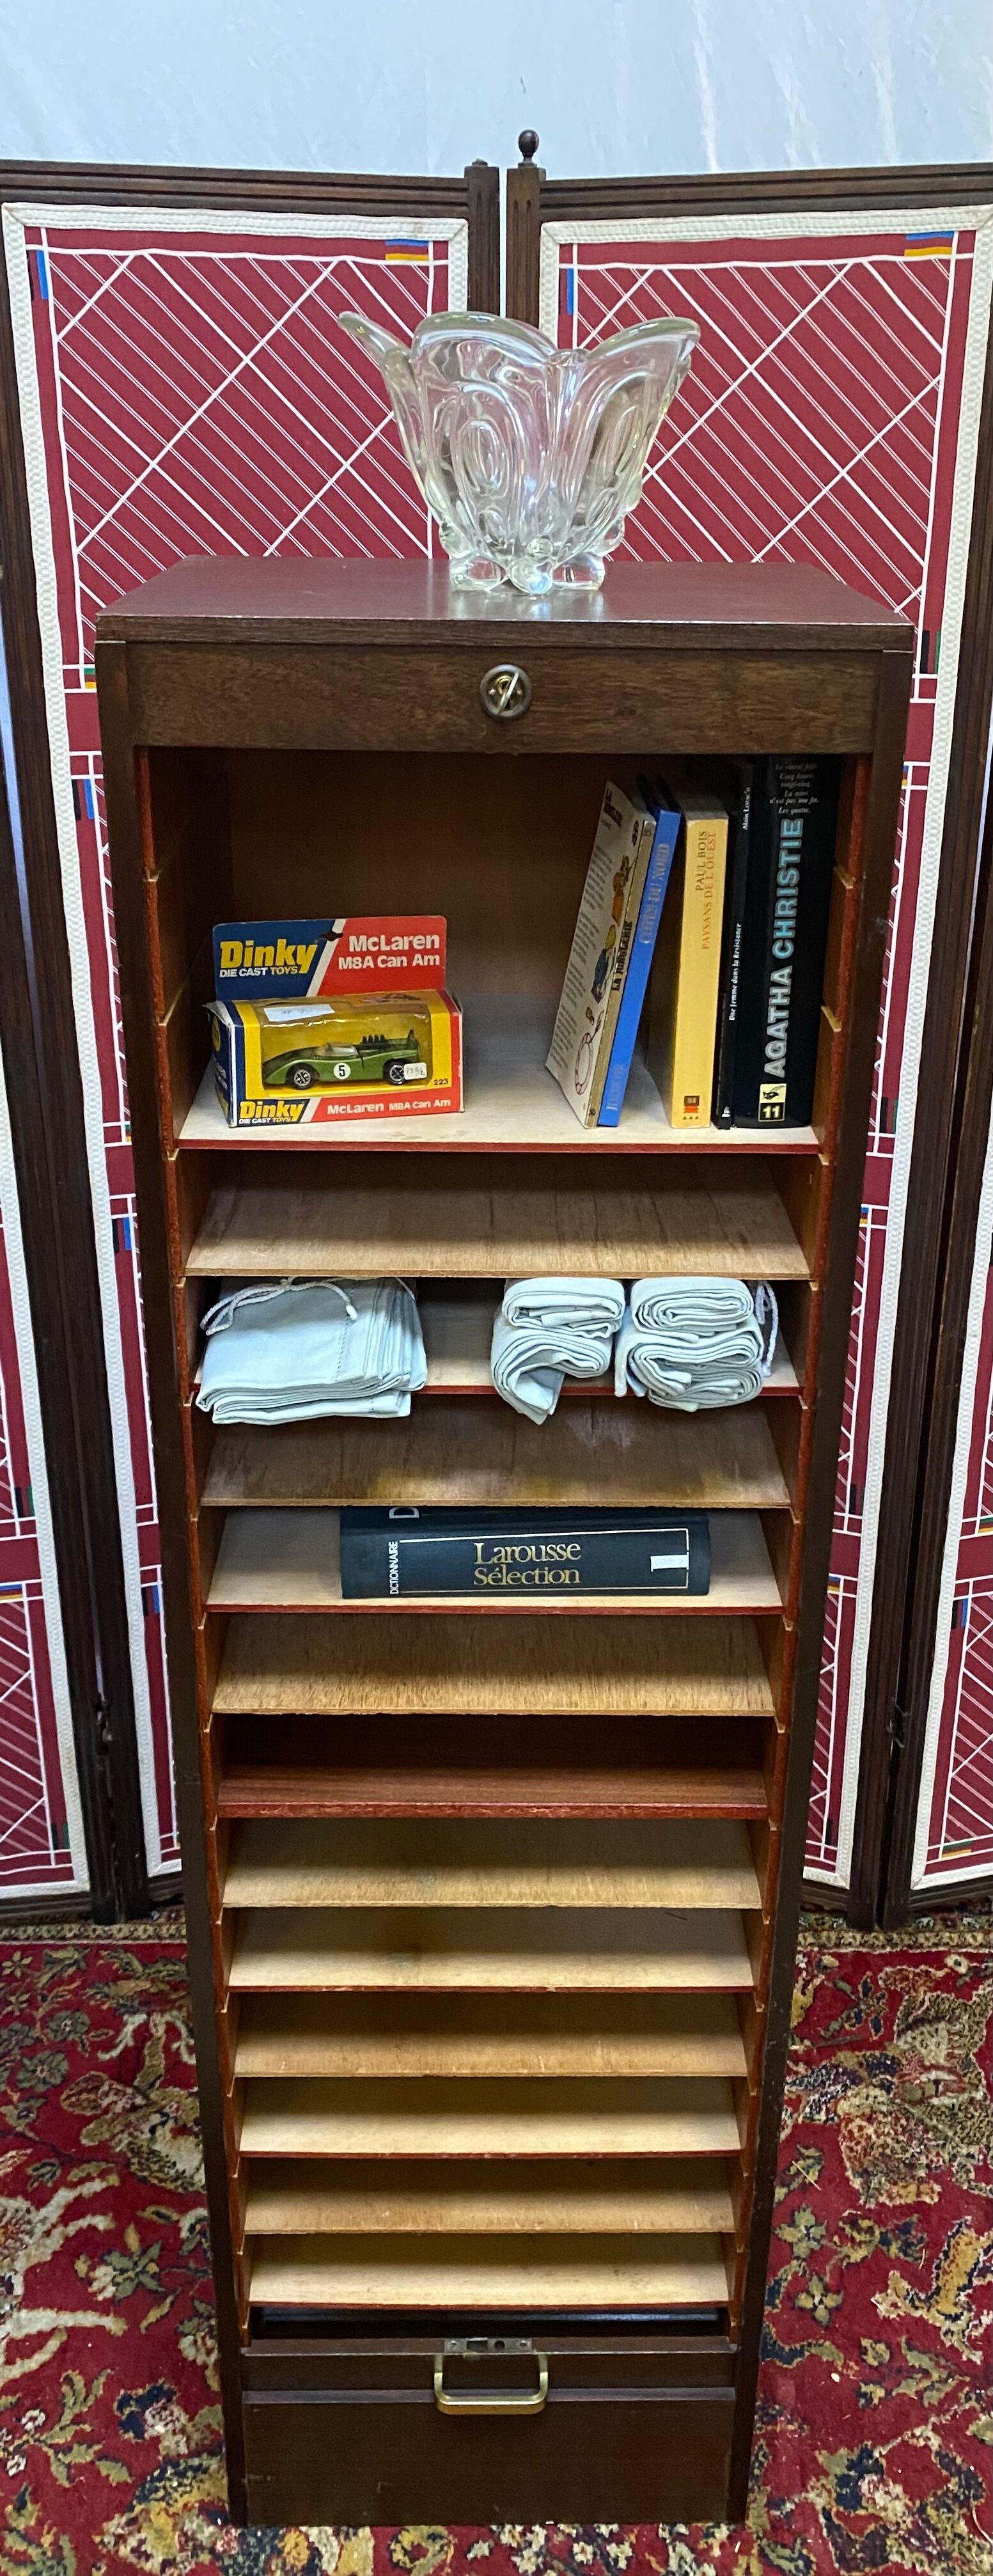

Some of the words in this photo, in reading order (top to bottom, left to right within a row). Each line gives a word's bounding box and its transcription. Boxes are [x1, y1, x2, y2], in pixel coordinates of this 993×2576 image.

[698, 831, 707, 858] BOIS
[696, 861, 706, 891] PAUL
[705, 883, 714, 898] DE
[772, 818, 804, 959] CHRISTIE
[701, 901, 712, 950] PAYSANS
[348, 934, 440, 952] McLaren
[220, 938, 318, 974] Dinky
[338, 955, 375, 970] M8A
[377, 955, 407, 968] Can
[412, 954, 440, 967] Am
[219, 968, 238, 978] DIE
[238, 966, 269, 977] CAST
[270, 966, 299, 975] TOYS
[611, 978, 622, 991] LA
[764, 964, 793, 1078] AGATHA
[339, 1065, 345, 1077] 5
[240, 1100, 305, 1122] Dinky
[327, 1103, 384, 1115] McLaren
[412, 1101, 430, 1109] Can
[434, 1099, 451, 1107] Am
[762, 1104, 780, 1119] 11
[474, 1543, 581, 1564] Larousse
[388, 1541, 399, 1594] DICTIONNAIRE
[473, 1564, 581, 1585] Sélection
